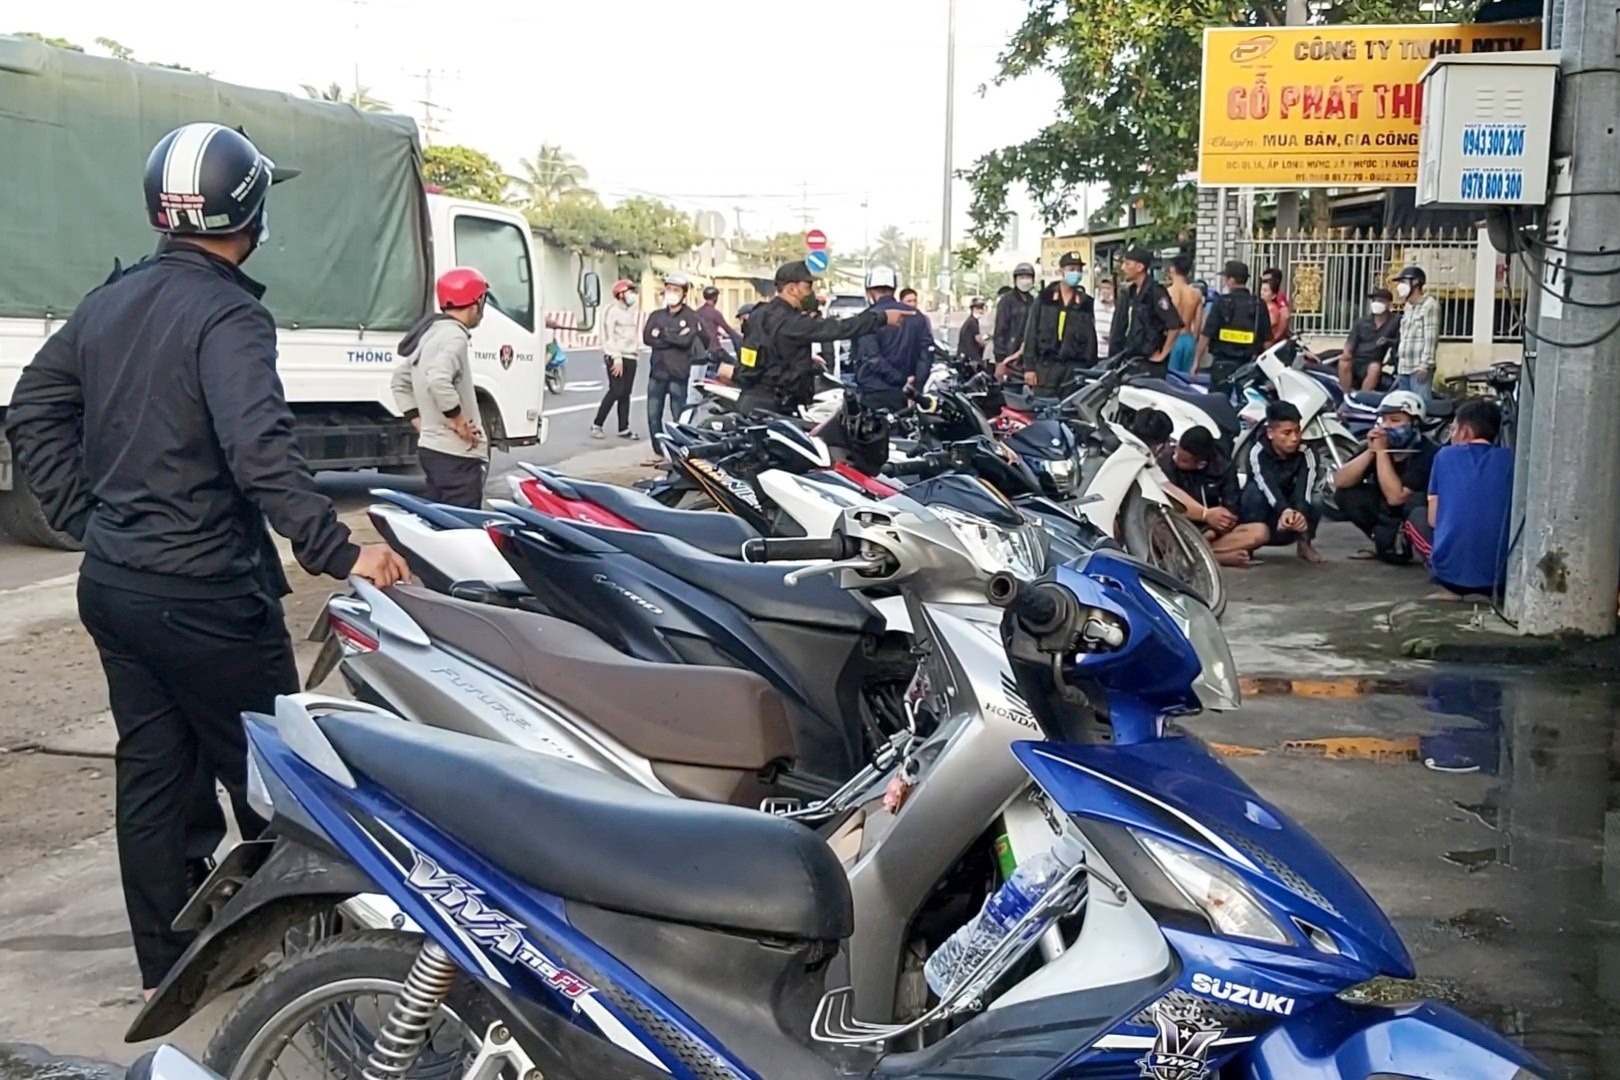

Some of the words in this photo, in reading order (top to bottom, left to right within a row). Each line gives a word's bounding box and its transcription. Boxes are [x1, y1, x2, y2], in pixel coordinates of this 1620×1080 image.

[1294, 36, 1356, 60] CÔNG
[1365, 40, 1392, 60] TY
[1399, 39, 1462, 60] TNHH
[1227, 73, 1270, 120] GỖ
[1281, 76, 1364, 119] PHÁT
[1263, 134, 1298, 147] MUA
[1344, 134, 1371, 146] GIA
[1375, 130, 1418, 146] CÔNG
[347, 348, 392, 362] THÔNG
[475, 352, 496, 360] TRAFFIC
[516, 354, 534, 362] POLICE
[985, 702, 1038, 731] HONDA
[1191, 973, 1295, 1015] SUZUKI
